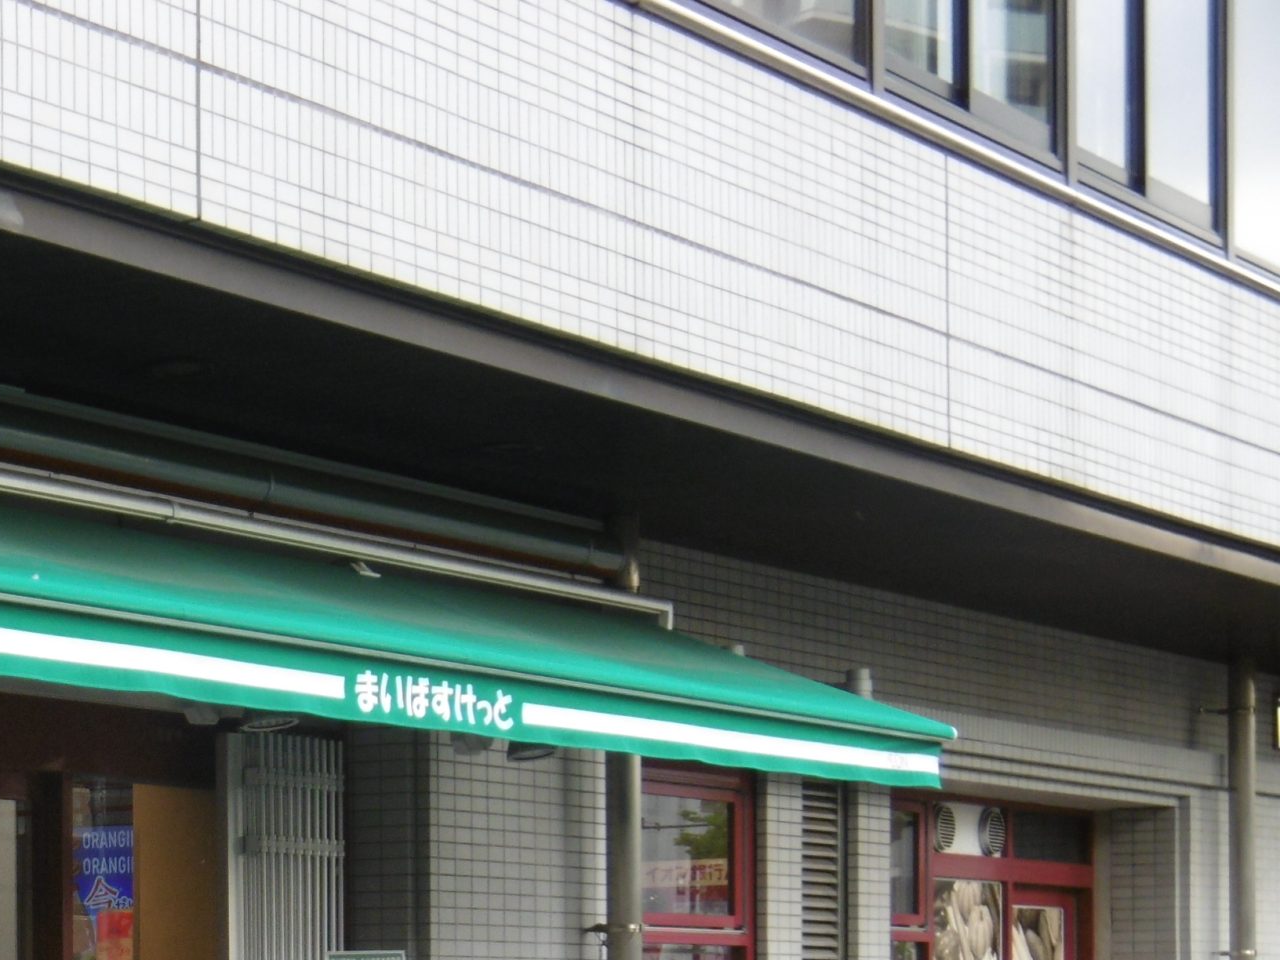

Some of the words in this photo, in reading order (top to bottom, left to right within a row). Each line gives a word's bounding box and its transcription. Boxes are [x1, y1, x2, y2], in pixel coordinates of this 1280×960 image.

[355, 670, 514, 730] まいばすけっと
